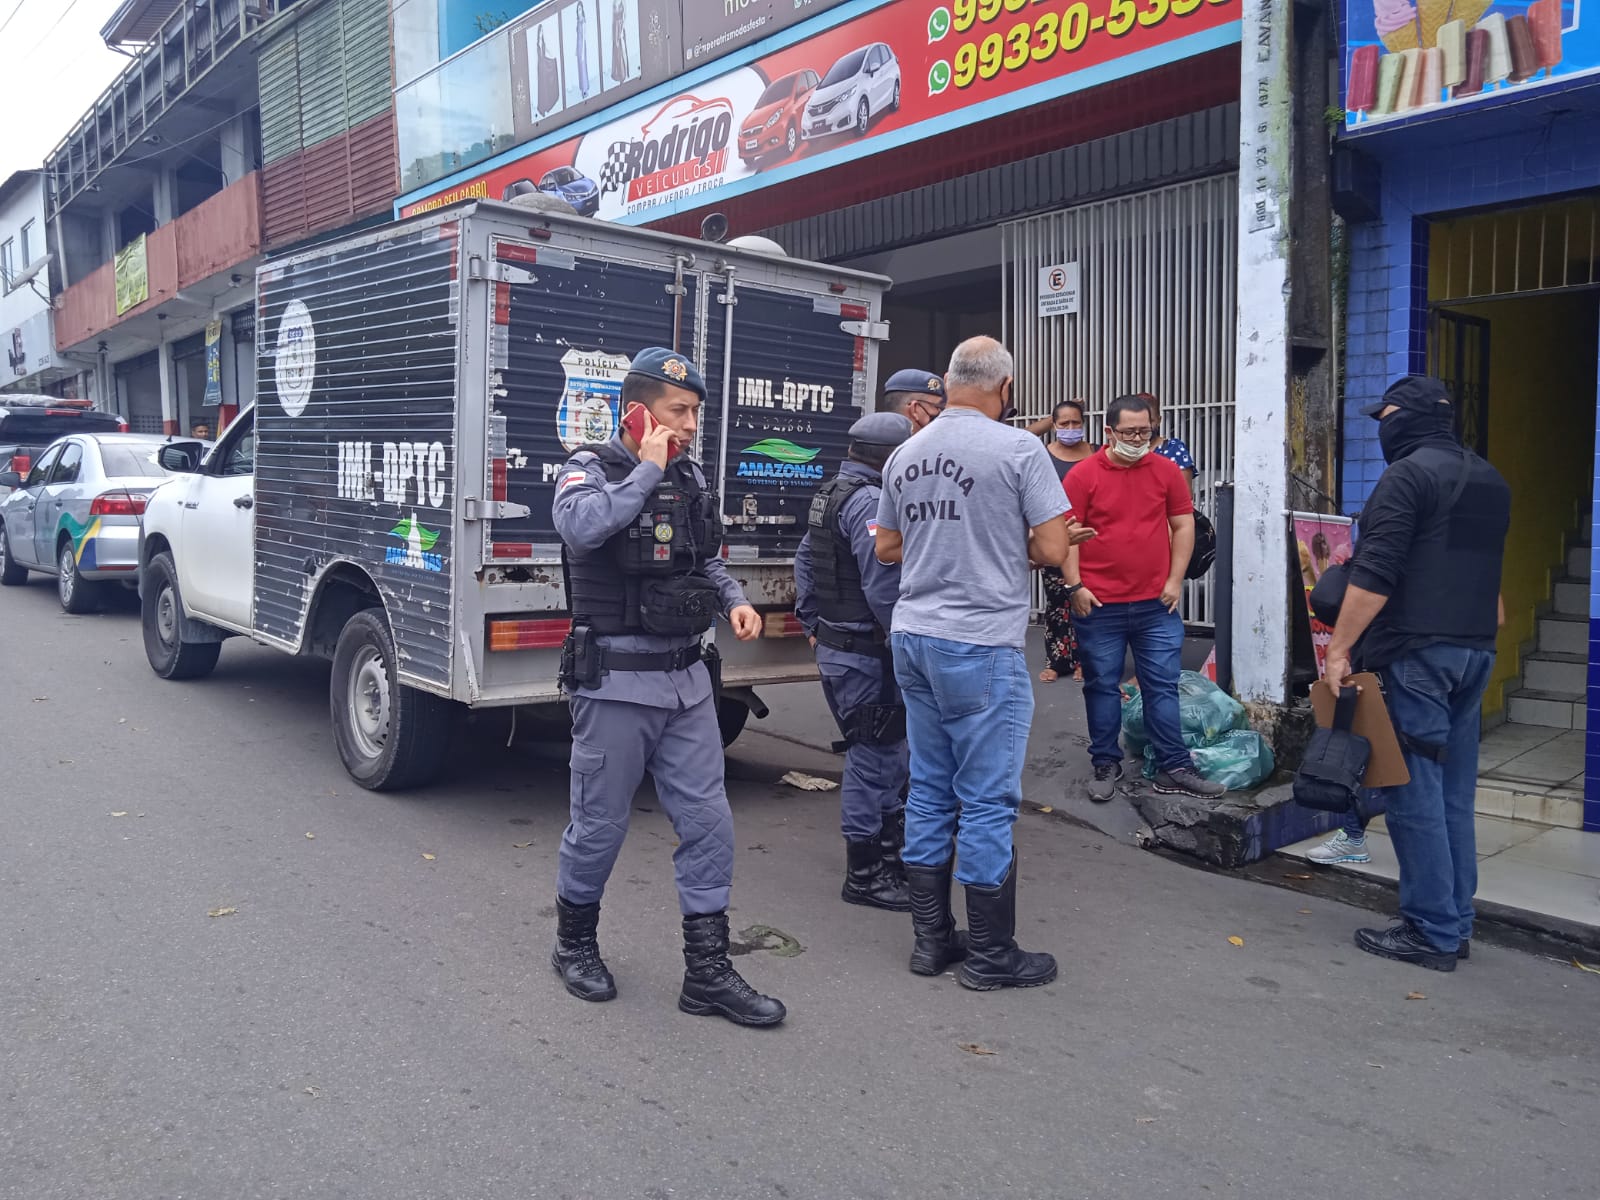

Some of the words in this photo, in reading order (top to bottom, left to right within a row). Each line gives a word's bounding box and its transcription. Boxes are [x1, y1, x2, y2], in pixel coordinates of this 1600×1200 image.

[624, 111, 732, 183] Rodrigo
[636, 158, 711, 197] VEÍCULOS
[578, 357, 618, 369] POLÍCIA
[584, 368, 611, 378] CIVIL
[736, 461, 825, 480] AMAZONAS
[894, 452, 975, 498] POLÍCIA
[905, 500, 961, 523] CIVIL
